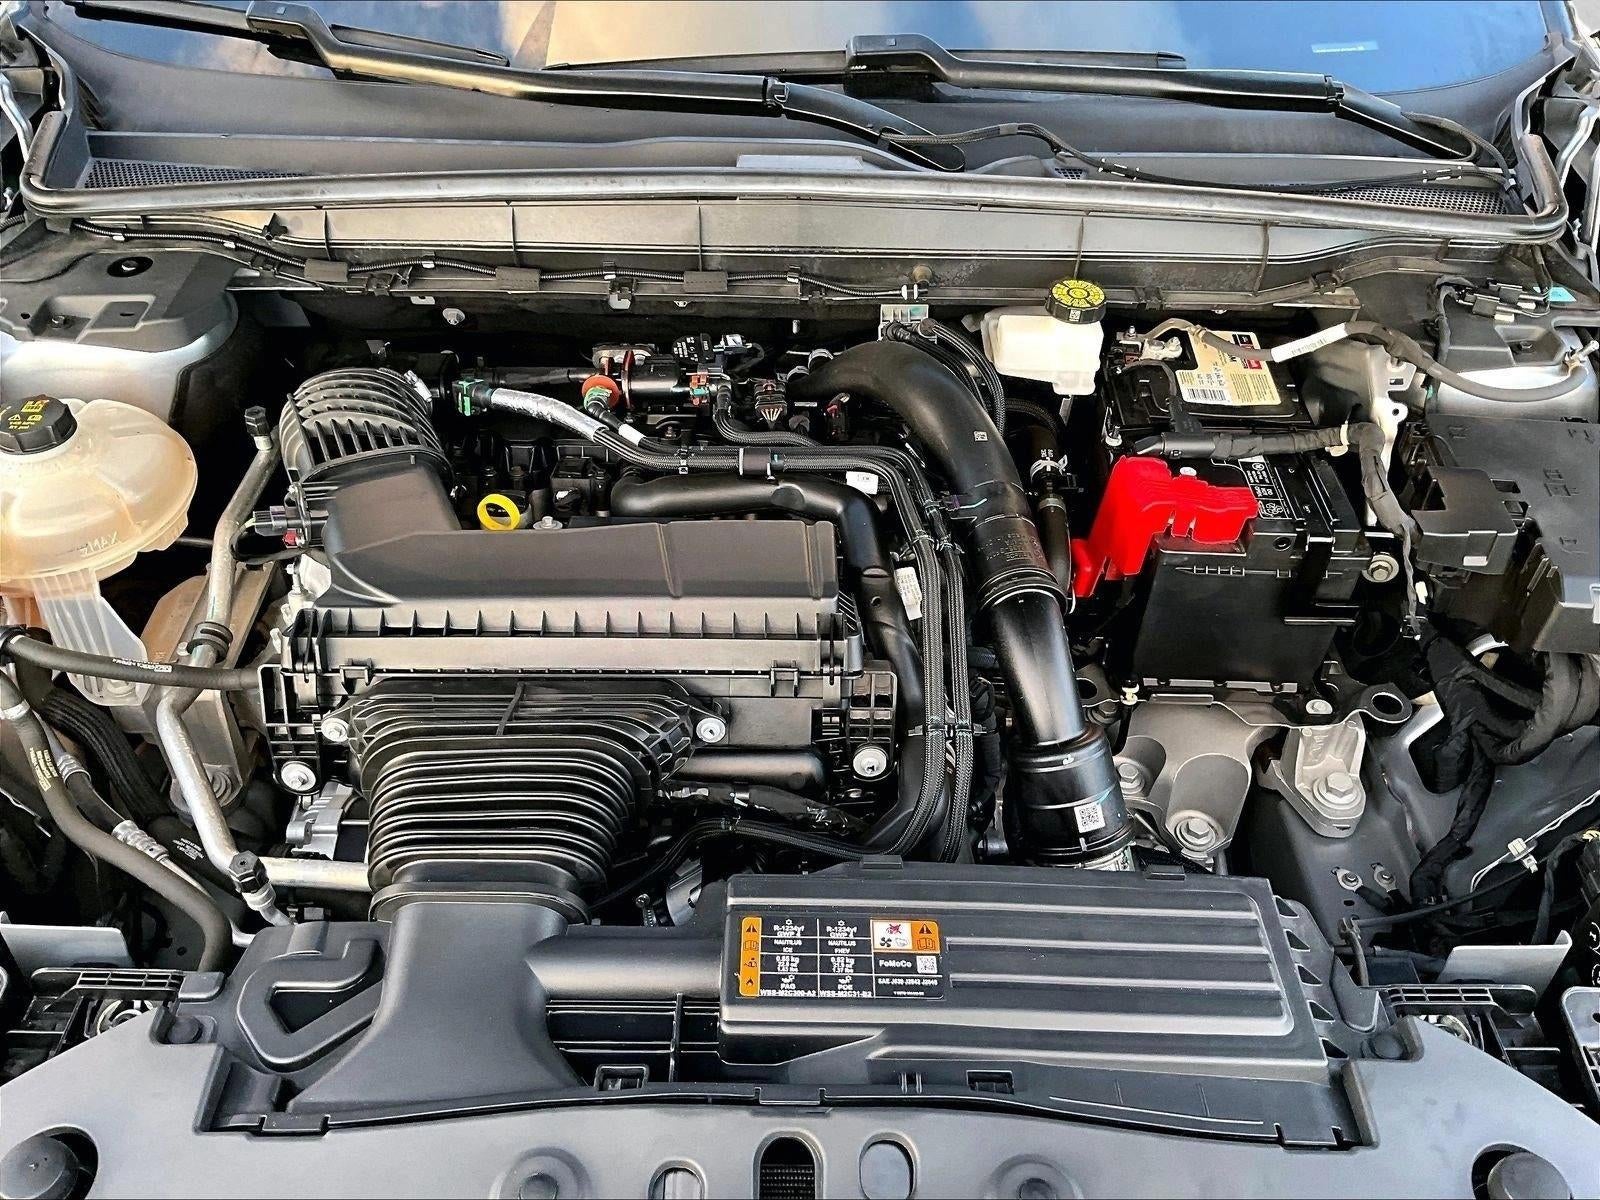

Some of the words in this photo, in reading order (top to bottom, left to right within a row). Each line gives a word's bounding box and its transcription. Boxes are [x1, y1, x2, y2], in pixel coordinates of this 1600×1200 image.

[773, 924, 805, 933] R-1234yf
[826, 926, 858, 934] R-1234yf
[790, 955, 800, 964] kg
[845, 957, 855, 965] kg
[879, 959, 912, 968] FoMoCo
